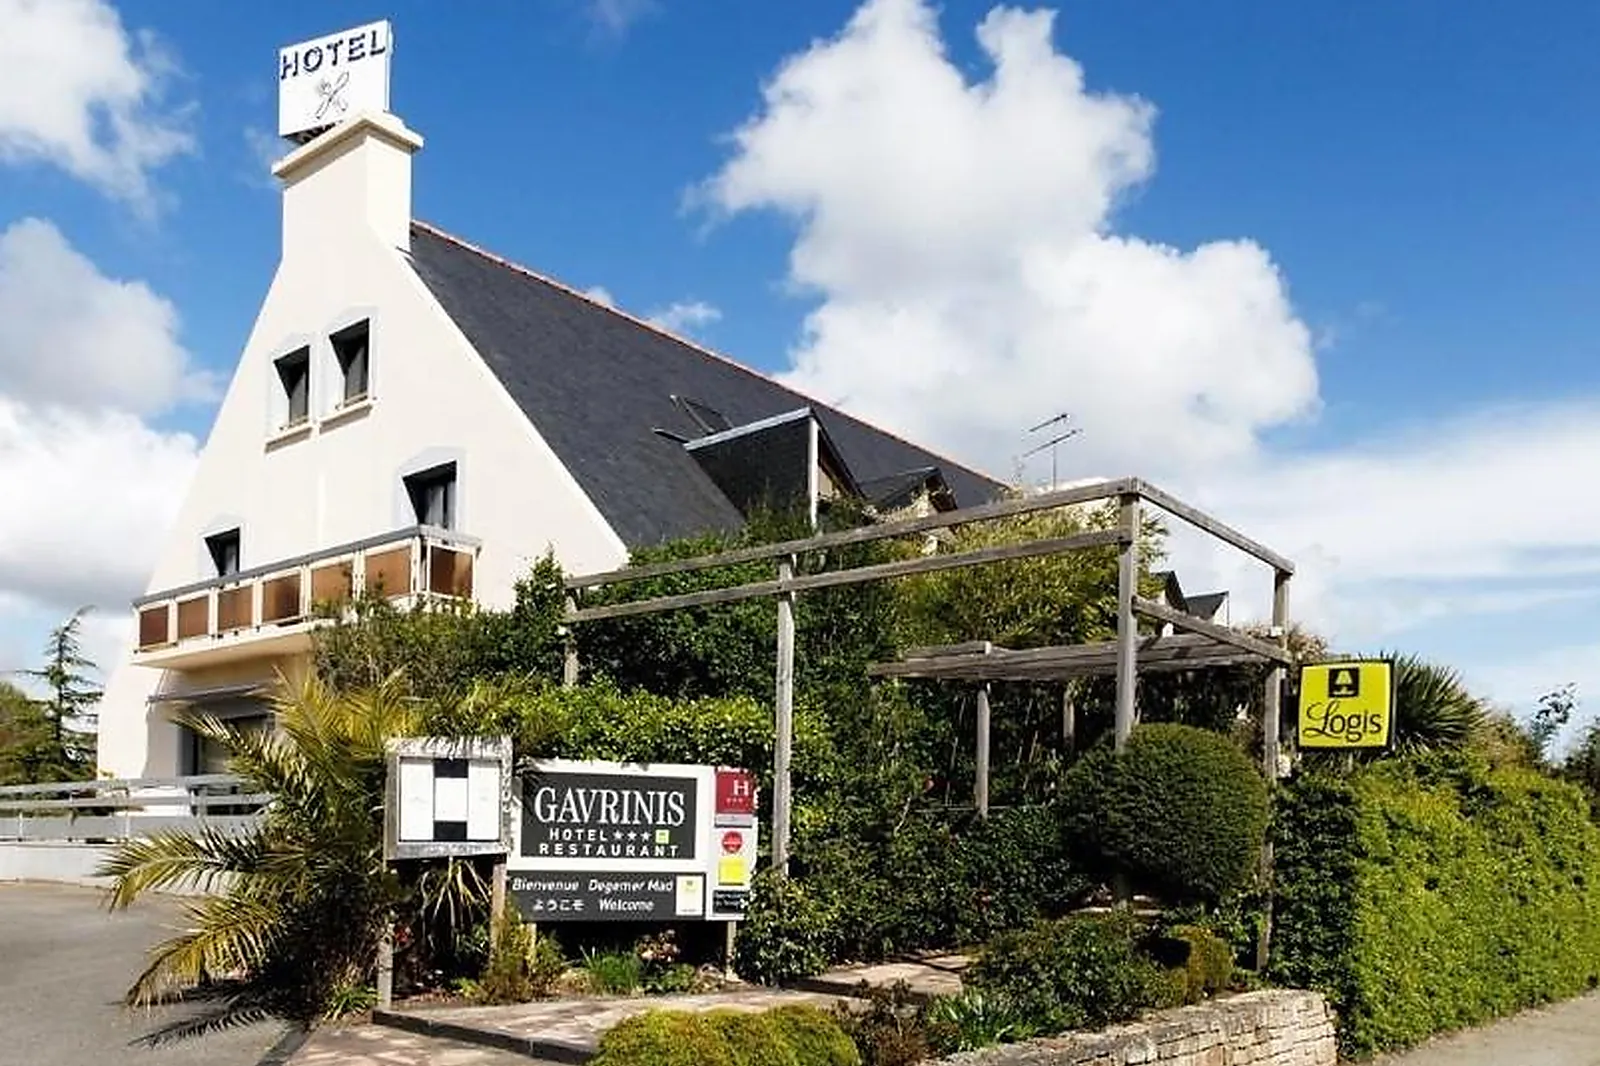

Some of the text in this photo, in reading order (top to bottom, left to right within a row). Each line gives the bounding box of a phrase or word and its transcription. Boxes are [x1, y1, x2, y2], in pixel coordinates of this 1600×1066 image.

[281, 30, 386, 80] HOTEL
[1303, 700, 1382, 743] Logis
[733, 781, 749, 797] H
[534, 786, 686, 826] GAVRINIS
[549, 829, 608, 842] HOTEL
[539, 843, 680, 857] RESTAURANT
[511, 878, 579, 892] Bienvenue
[647, 879, 674, 893] Mad
[599, 898, 655, 911] Welcome
